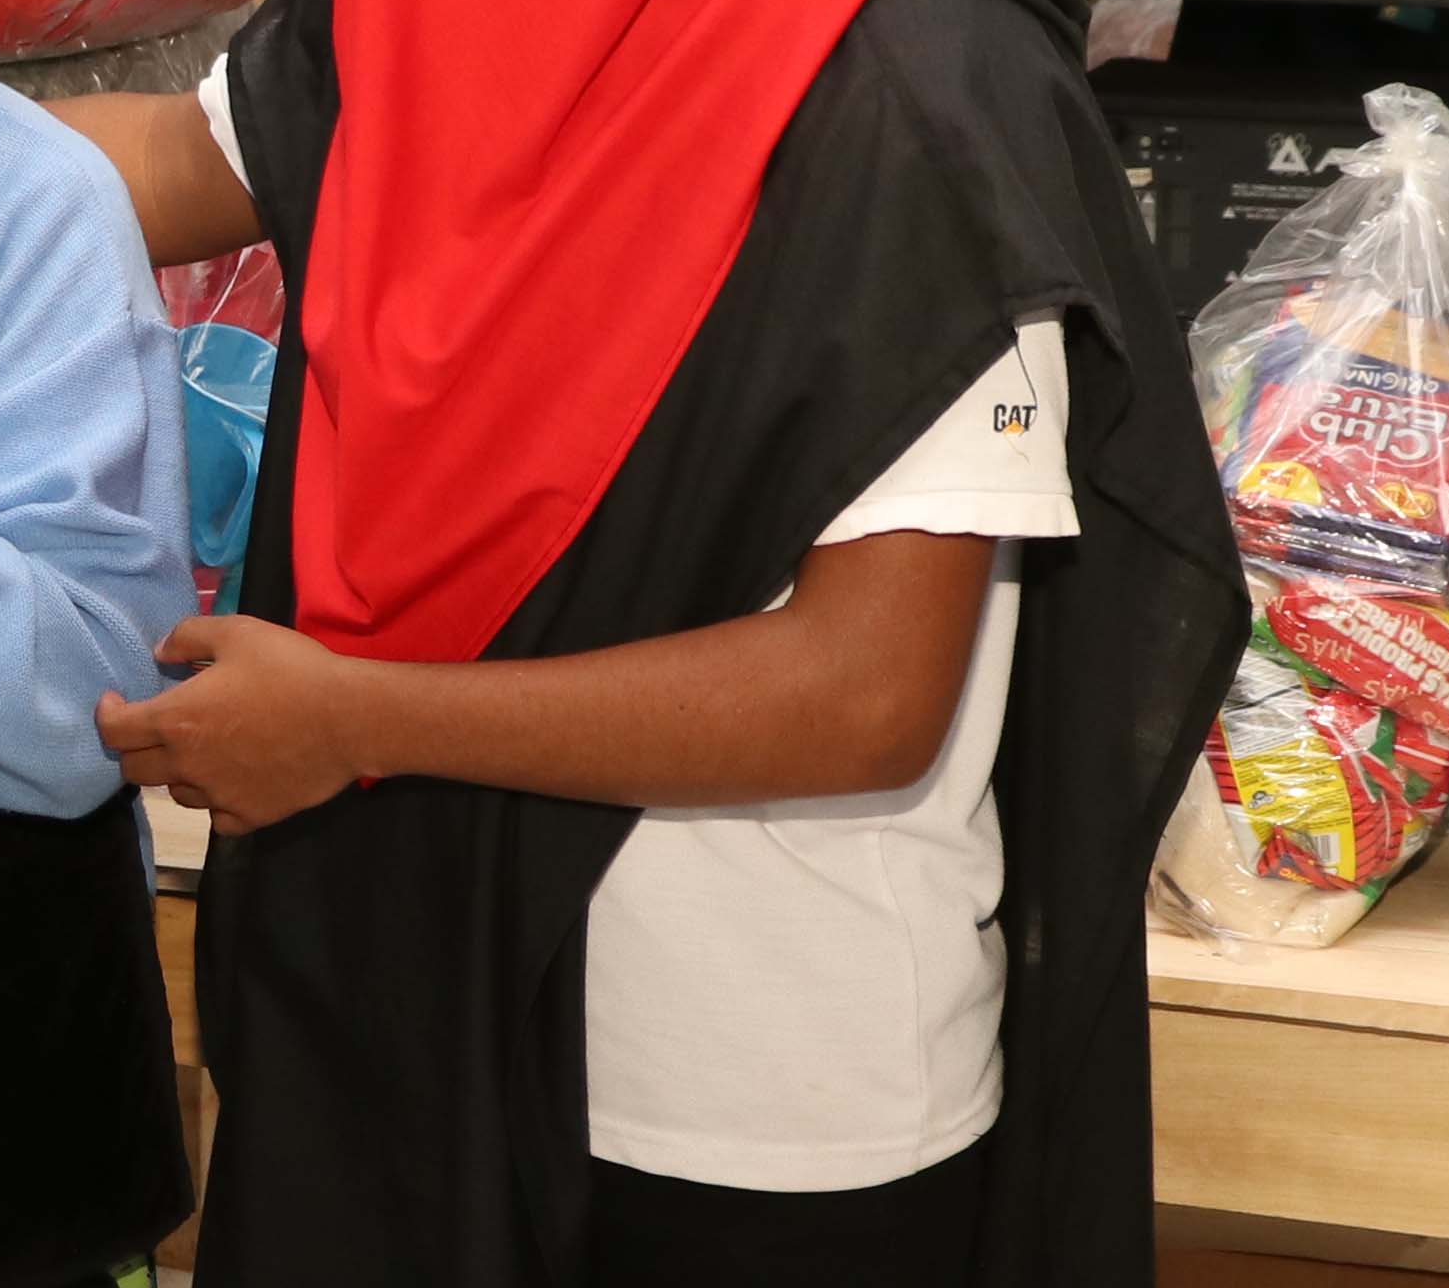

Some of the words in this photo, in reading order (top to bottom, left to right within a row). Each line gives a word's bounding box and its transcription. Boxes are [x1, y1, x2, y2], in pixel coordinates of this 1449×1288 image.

[993, 403, 1038, 433] CAT
[1320, 390, 1449, 435] Extra
[1309, 413, 1430, 461] Club
[1294, 631, 1356, 664] MÁS
